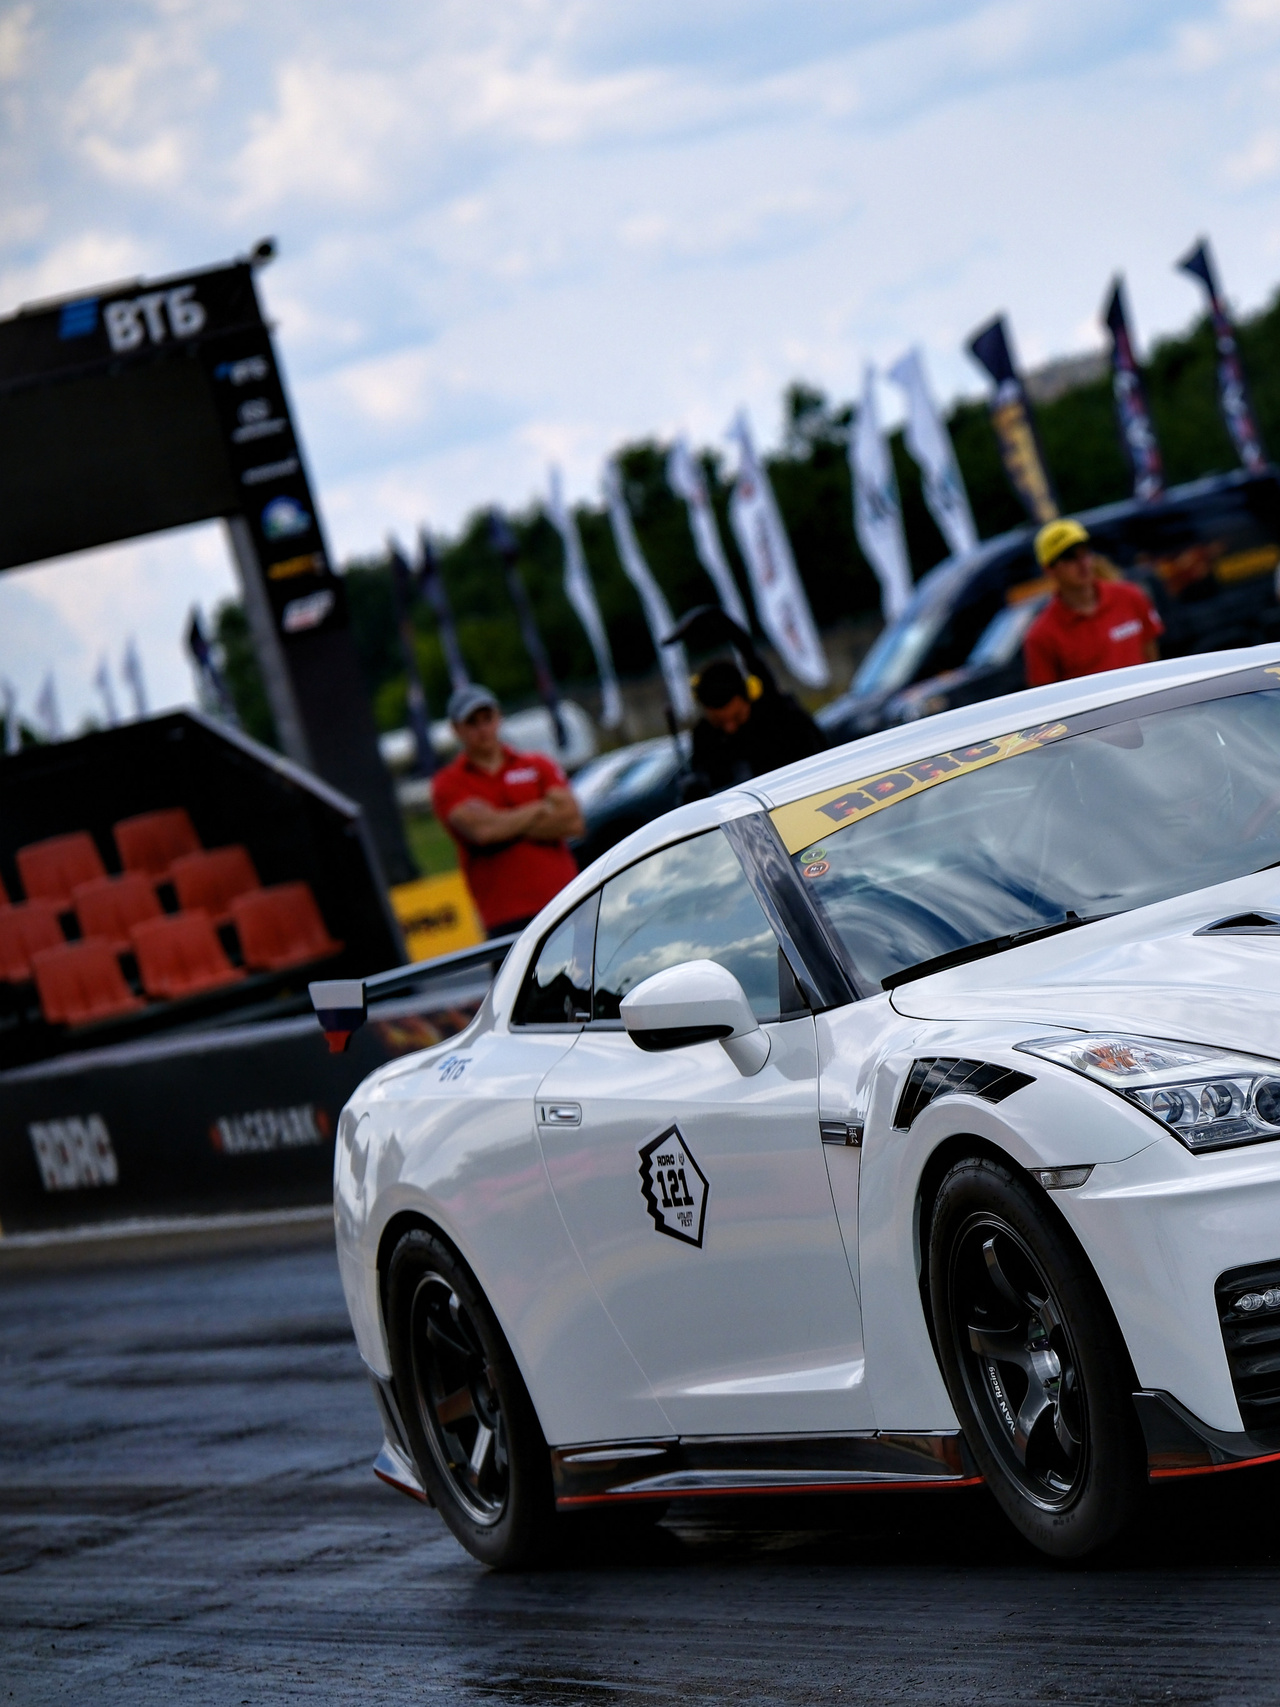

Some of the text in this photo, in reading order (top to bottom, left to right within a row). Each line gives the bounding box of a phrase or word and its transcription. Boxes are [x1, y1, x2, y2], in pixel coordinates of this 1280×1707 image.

[103, 285, 207, 353] ВТБ
[814, 740, 1001, 822] RDRC
[656, 1168, 694, 1208] 121
[989, 1366, 1002, 1398] Racing
